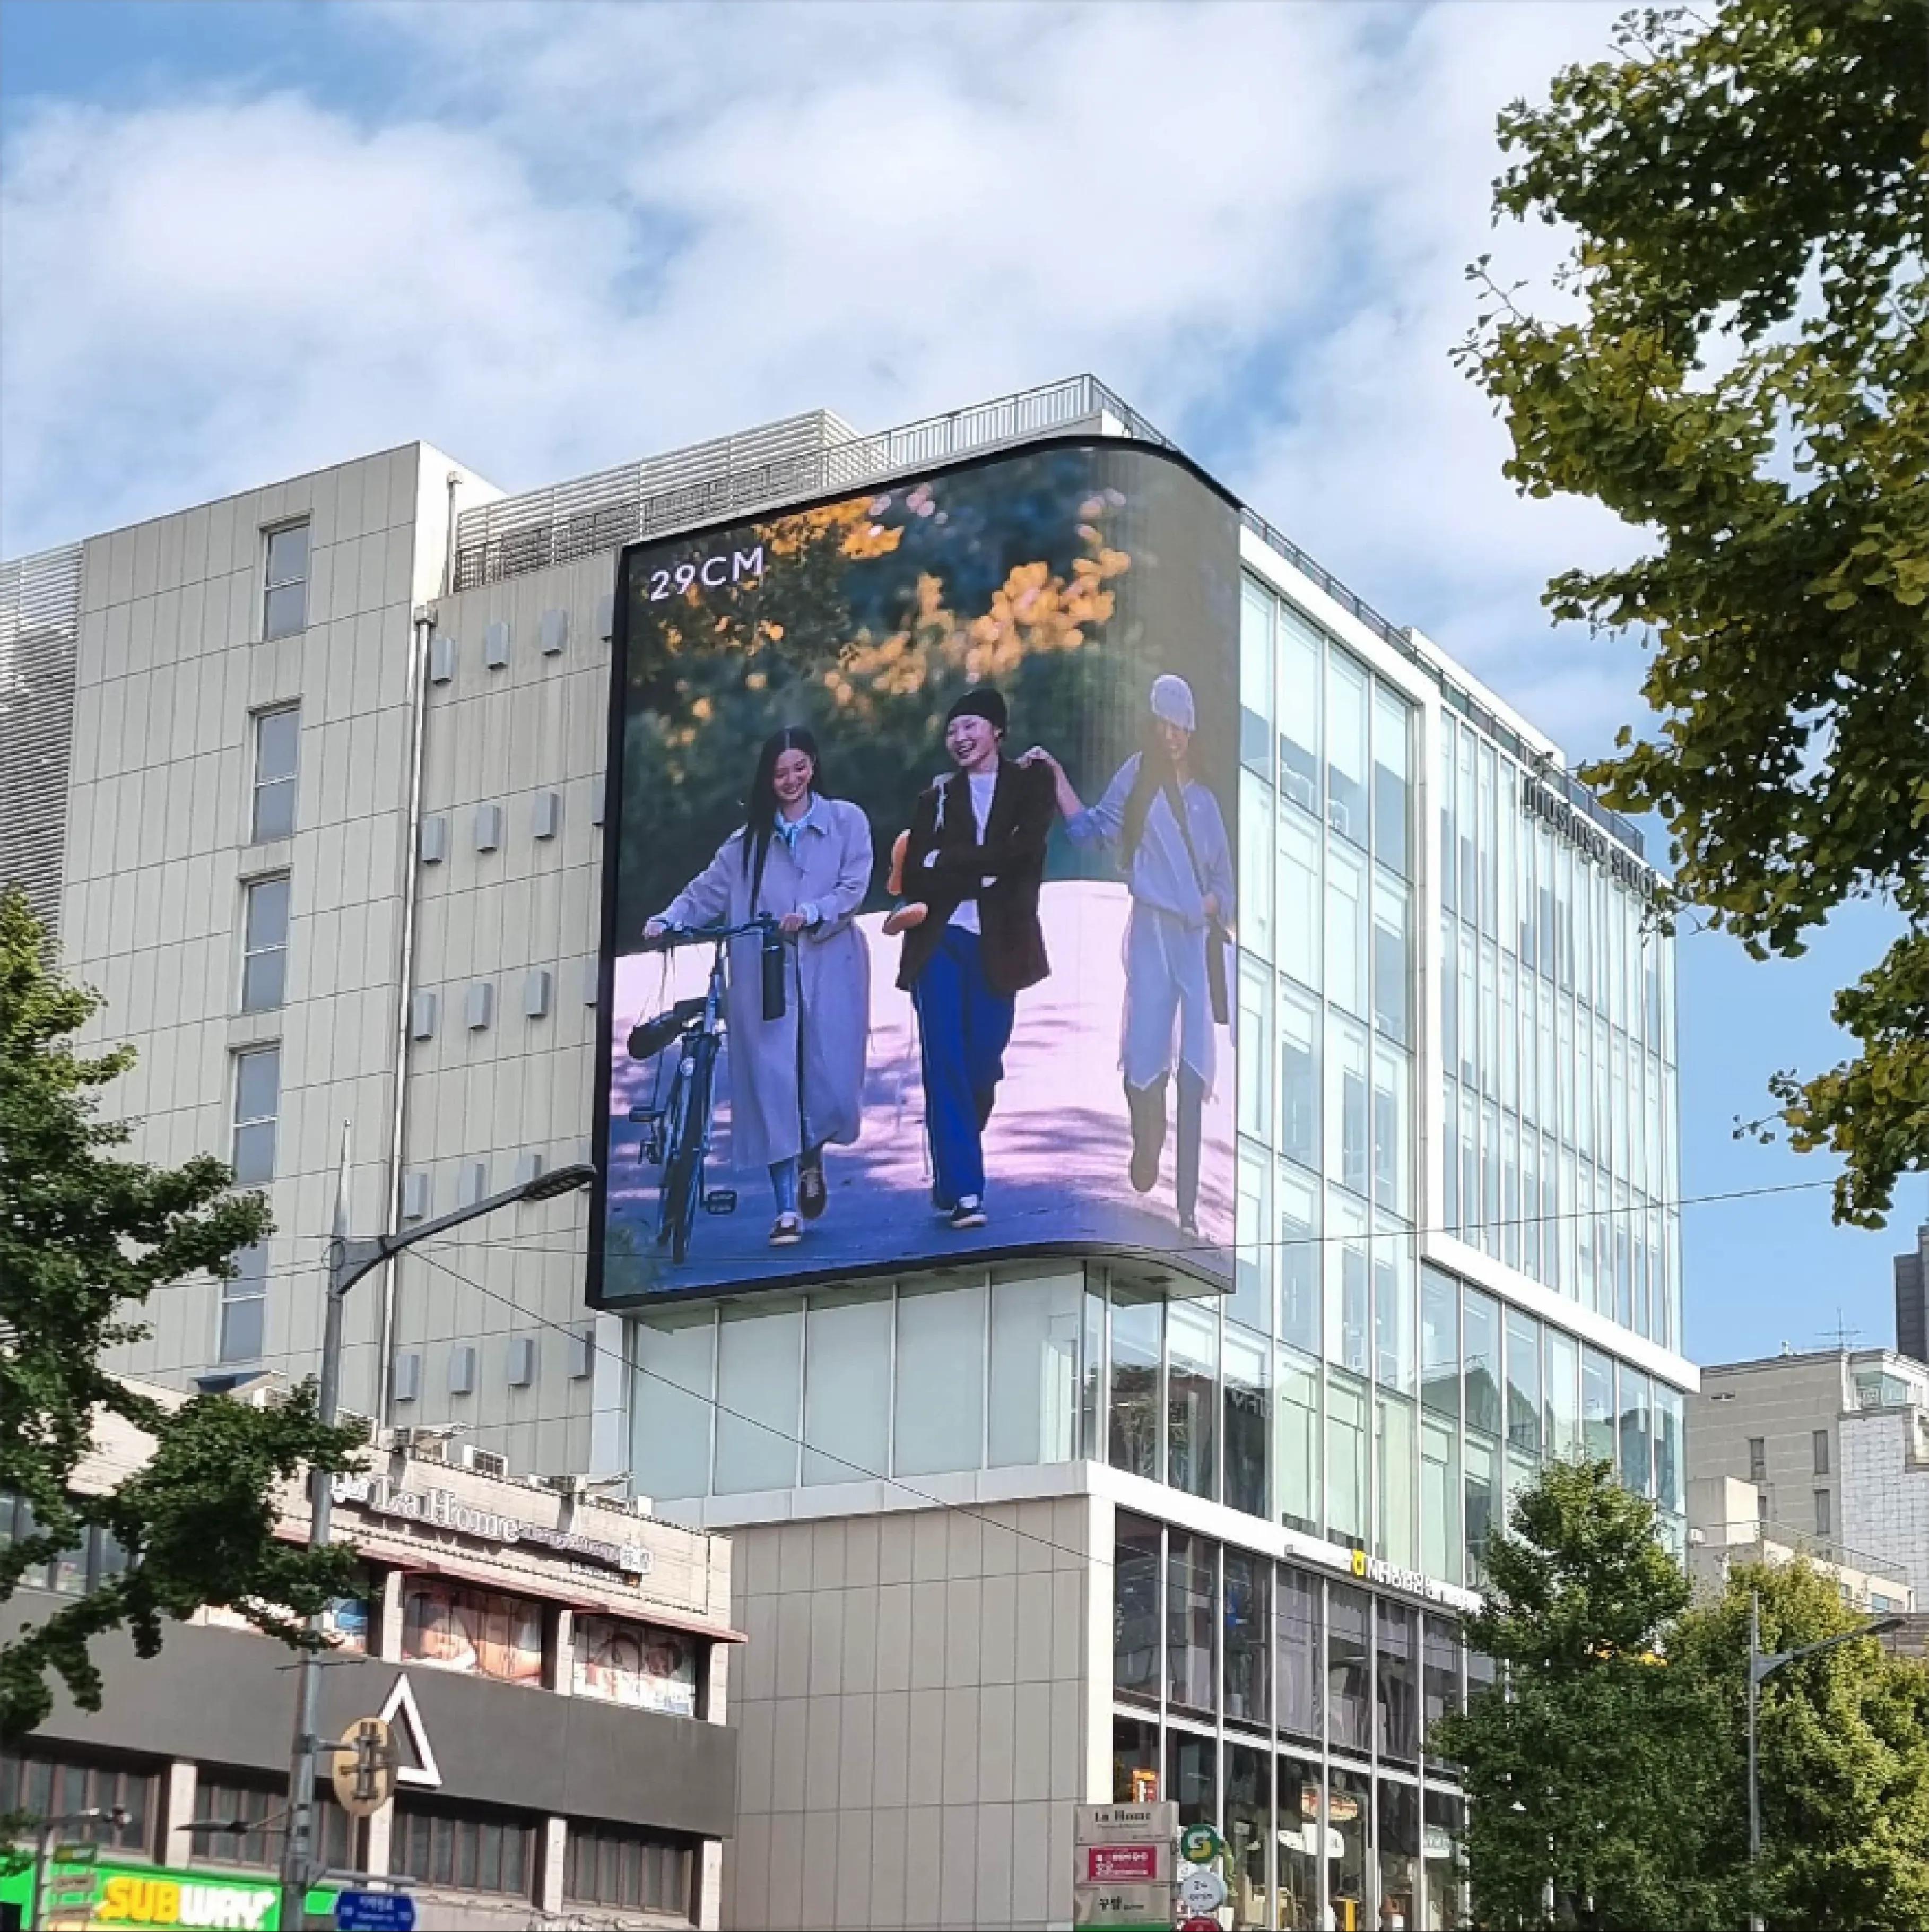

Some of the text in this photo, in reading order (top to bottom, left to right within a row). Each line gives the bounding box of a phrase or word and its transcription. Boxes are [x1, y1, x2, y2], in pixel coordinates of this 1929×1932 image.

[650, 547, 763, 601] 29CM
[370, 1475, 420, 1519] La
[424, 1487, 520, 1543] Home
[97, 1876, 275, 1930] SUBWAY
